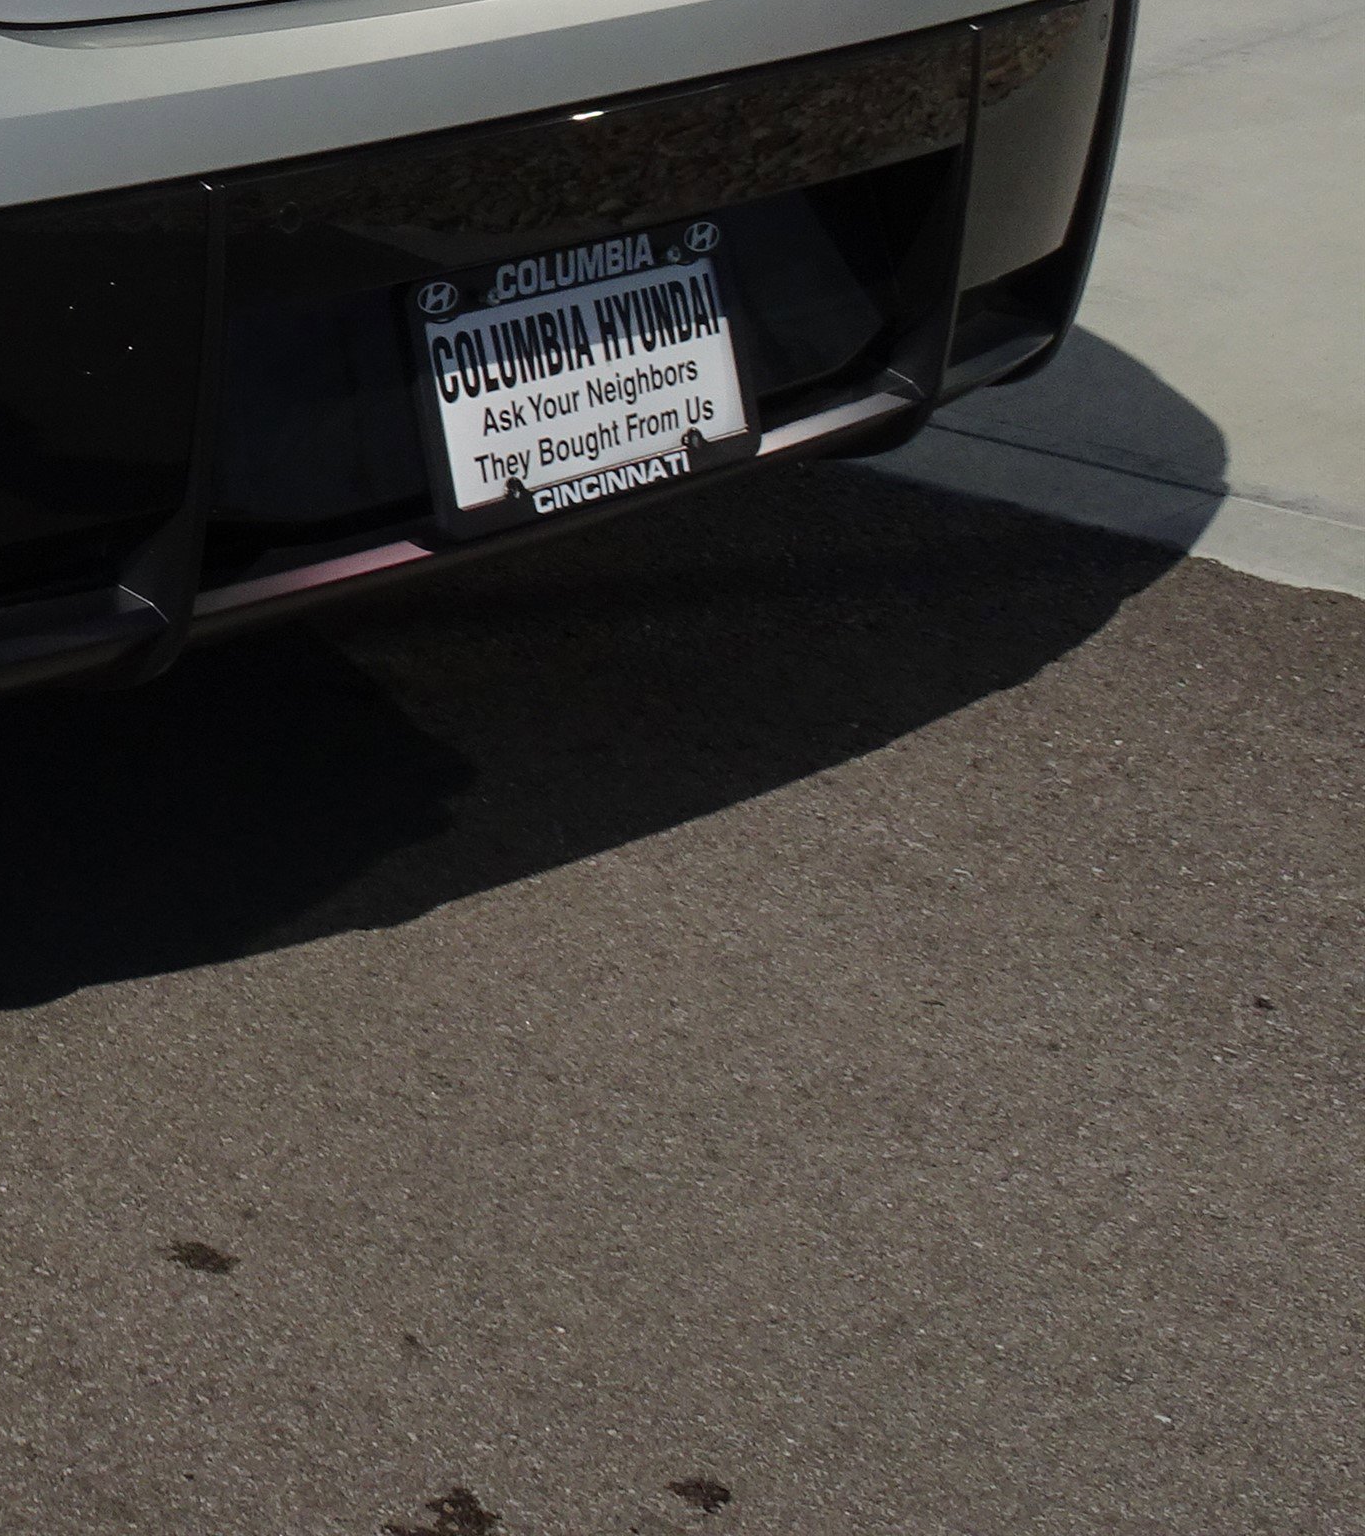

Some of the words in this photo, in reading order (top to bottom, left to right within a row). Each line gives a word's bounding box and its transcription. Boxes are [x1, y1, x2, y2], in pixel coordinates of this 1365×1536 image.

[495, 232, 655, 301] COLUMBIA
[431, 302, 596, 404] COLUMBIA
[593, 272, 721, 362] HYUNDAI
[483, 400, 527, 437] Ask
[528, 389, 580, 422] Your
[586, 359, 699, 412] Neighbors
[474, 447, 531, 484] They
[539, 419, 620, 467] Bought
[625, 407, 679, 443] From
[685, 395, 715, 426] Us
[531, 449, 692, 515] CINCINNATI
